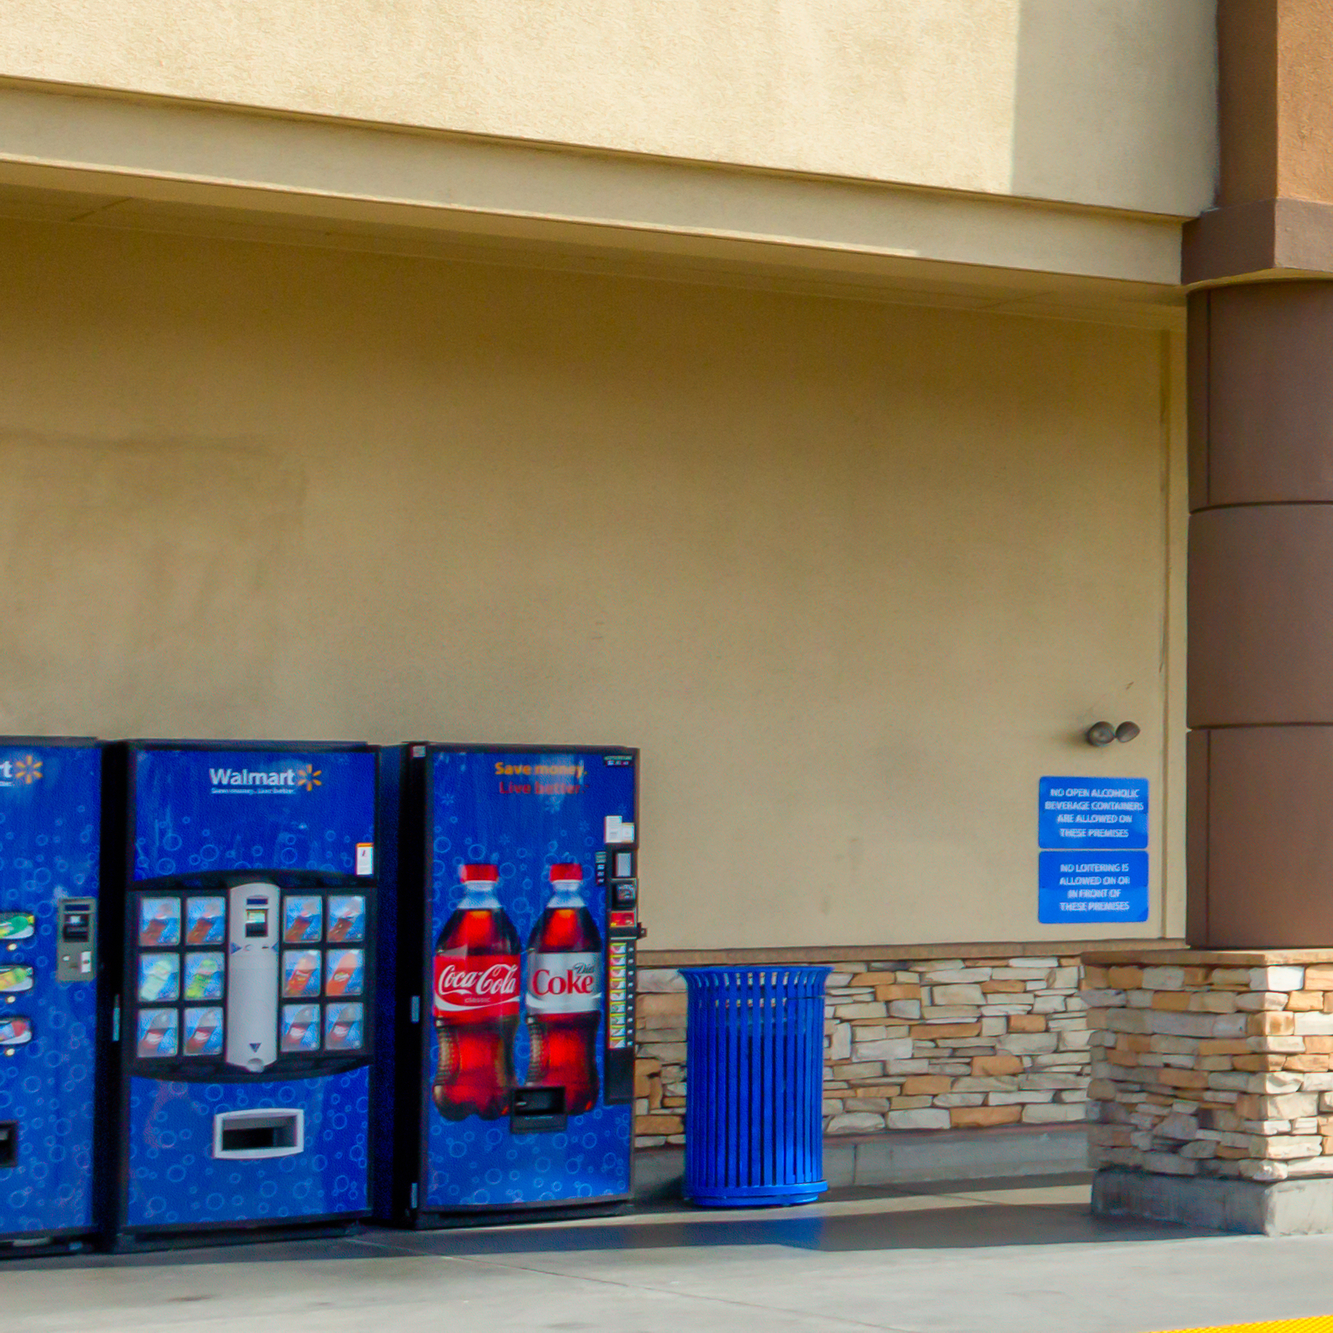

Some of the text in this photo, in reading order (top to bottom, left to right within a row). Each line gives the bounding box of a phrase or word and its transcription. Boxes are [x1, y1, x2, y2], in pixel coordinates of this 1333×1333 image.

[495, 762, 588, 778] Save money.
[209, 768, 295, 786] Walmart
[499, 781, 531, 794] Live
[1050, 788, 1140, 798] NO OPEN ALCOHOLIC
[1045, 801, 1144, 811] BEVERAGE CONTAINERS
[1057, 814, 1133, 823] ARE ALLOWED ON
[1060, 828, 1129, 837] THESE PREMISES
[1060, 863, 1130, 872] NO LOITERING IS
[1059, 876, 1131, 885] ALLOWED ON OR
[1067, 889, 1122, 898] IN FRONT OF
[1060, 902, 1130, 911] THESE PREMISES
[438, 964, 519, 995] Coca-Cola
[532, 969, 594, 996] Coke
